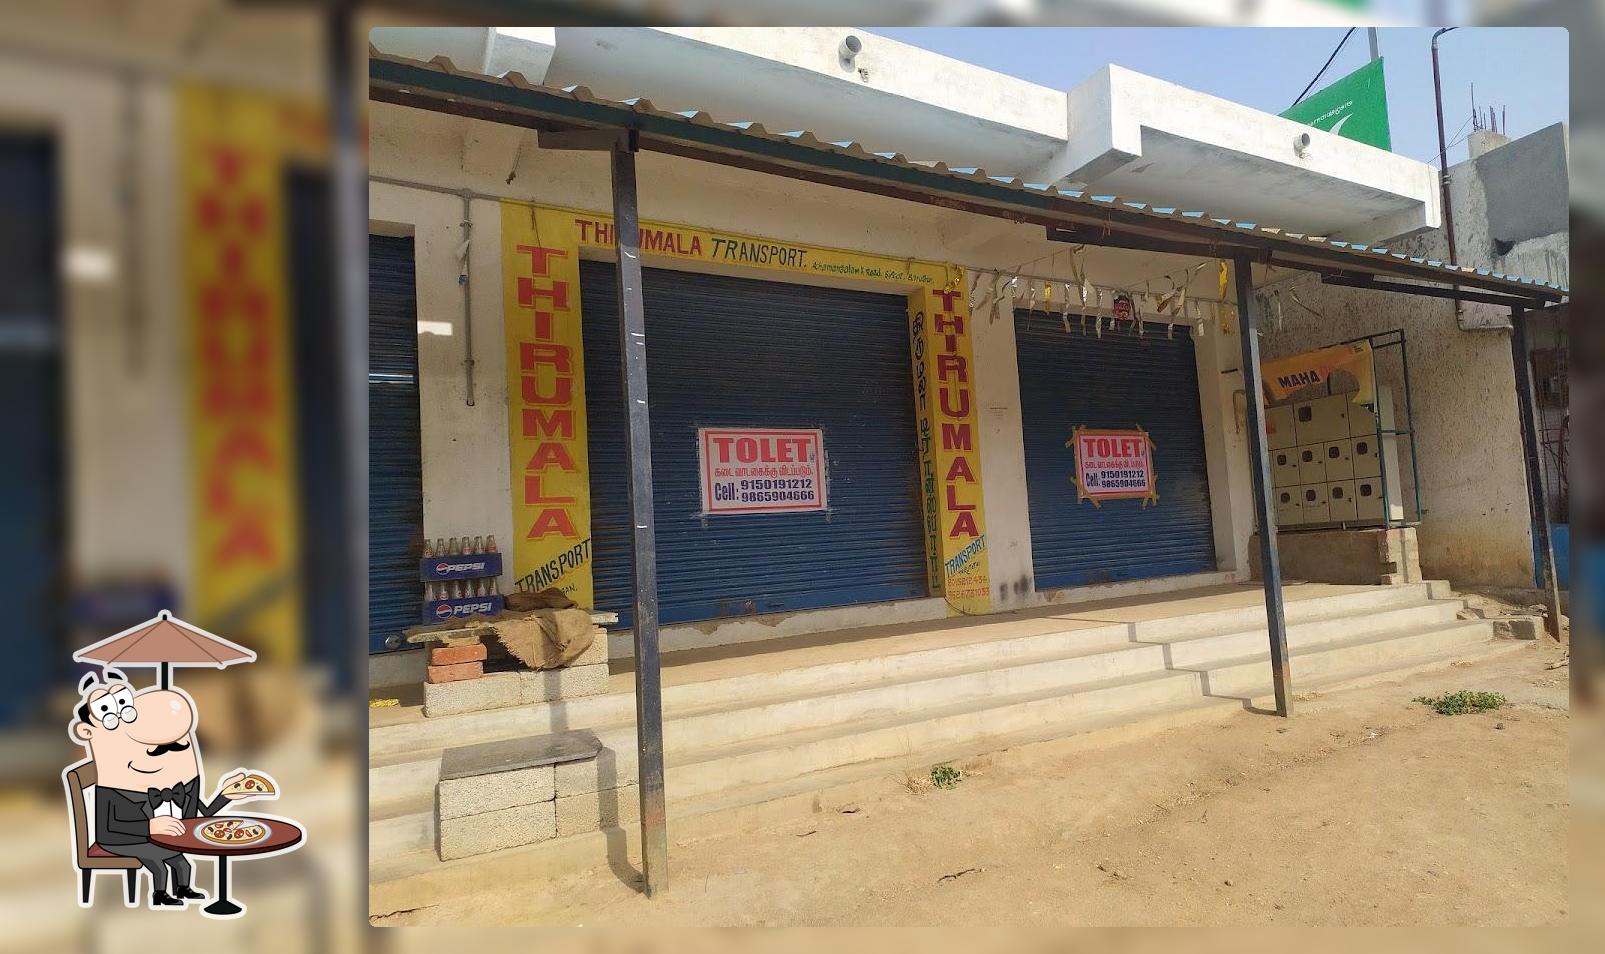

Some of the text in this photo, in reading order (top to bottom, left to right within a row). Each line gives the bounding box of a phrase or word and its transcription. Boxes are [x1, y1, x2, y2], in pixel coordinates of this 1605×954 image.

[575, 219, 702, 256] THIMALA
[1277, 370, 1320, 388] MAHA
[516, 245, 577, 539] THIRUMALA
[932, 289, 979, 537] THIRUMALA
[713, 437, 811, 463] TOLET
[1083, 438, 1142, 458] TOLET
[741, 479, 812, 490] 9150191212
[741, 490, 815, 502] 9865904666
[447, 562, 486, 572] PEPSI
[515, 538, 591, 593] TRANSPORT
[944, 534, 985, 577] TRANSPORT
[453, 602, 492, 615] PEPSI
